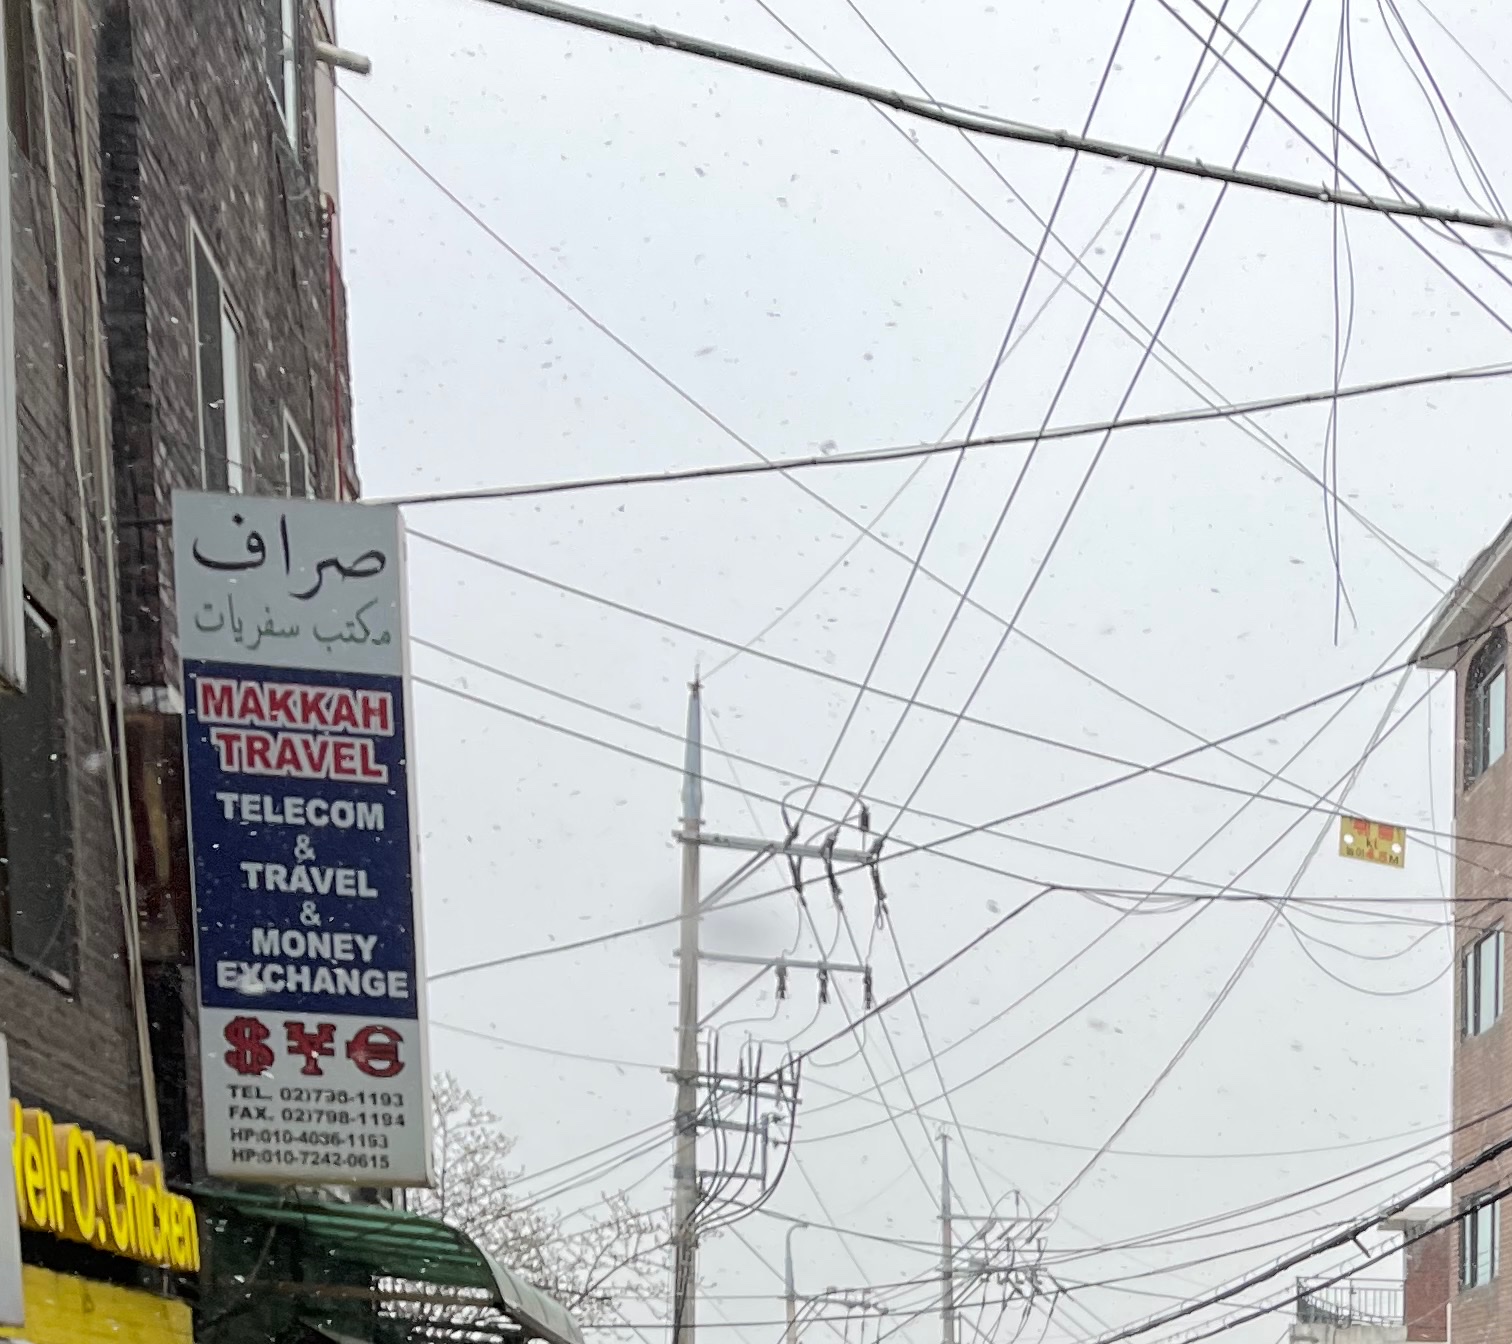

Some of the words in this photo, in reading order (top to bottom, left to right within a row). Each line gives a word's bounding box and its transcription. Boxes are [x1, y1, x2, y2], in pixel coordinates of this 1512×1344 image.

[192, 512, 386, 599] صراف
[194, 593, 300, 650] سفريات
[312, 597, 391, 653] مكتب
[197, 679, 392, 734] MAKKAH
[213, 729, 387, 781] TRAVEL
[216, 791, 385, 831] TELECOM
[294, 832, 316, 861] &
[240, 861, 378, 898] TRAVEL
[299, 900, 322, 927] &
[252, 928, 378, 962] MONEY
[216, 961, 409, 999] EXCHANGE
[229, 1106, 274, 1122] FAX.
[100, 1140, 201, 1273] Chicken
